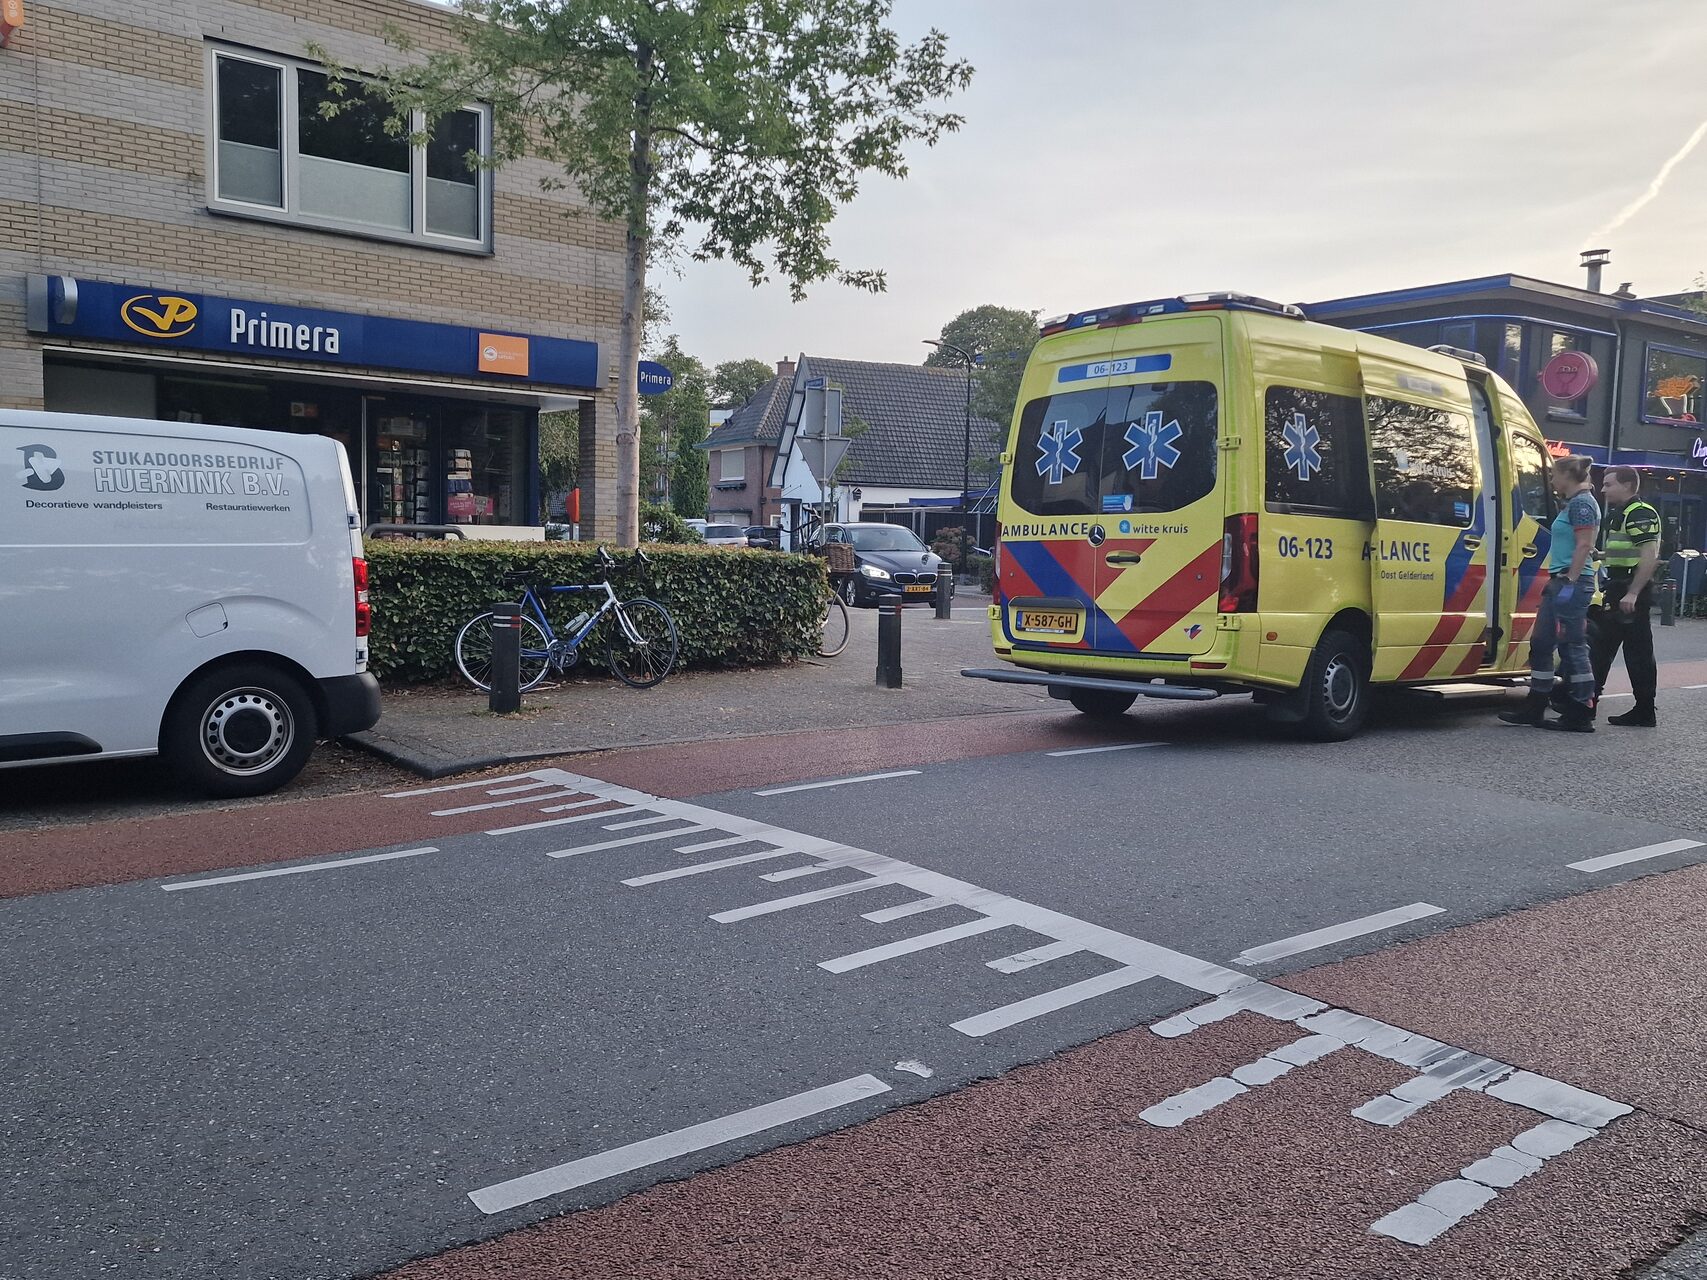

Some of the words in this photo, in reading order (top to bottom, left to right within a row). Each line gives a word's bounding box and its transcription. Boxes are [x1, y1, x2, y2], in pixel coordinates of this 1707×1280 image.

[230, 308, 339, 354] Primera
[1094, 361, 1129, 375] 06-123
[640, 371, 672, 386] Primera
[92, 450, 285, 471] STUKADOORSBEDRIJF
[94, 467, 235, 495] HUERNINK
[242, 471, 290, 496] B.V.
[25, 500, 89, 509] Decoratieve
[93, 501, 163, 511] wandpleisters
[206, 502, 291, 513] Restauratiewerken
[1002, 522, 1089, 537] AMBULANCE
[1133, 523, 1160, 534] witte
[1162, 523, 1189, 534] kruis
[1278, 535, 1333, 560] 06-123
[1380, 570, 1397, 580] Oost
[1398, 570, 1434, 581] Gelderland
[1024, 613, 1073, 629] X-587-GH
